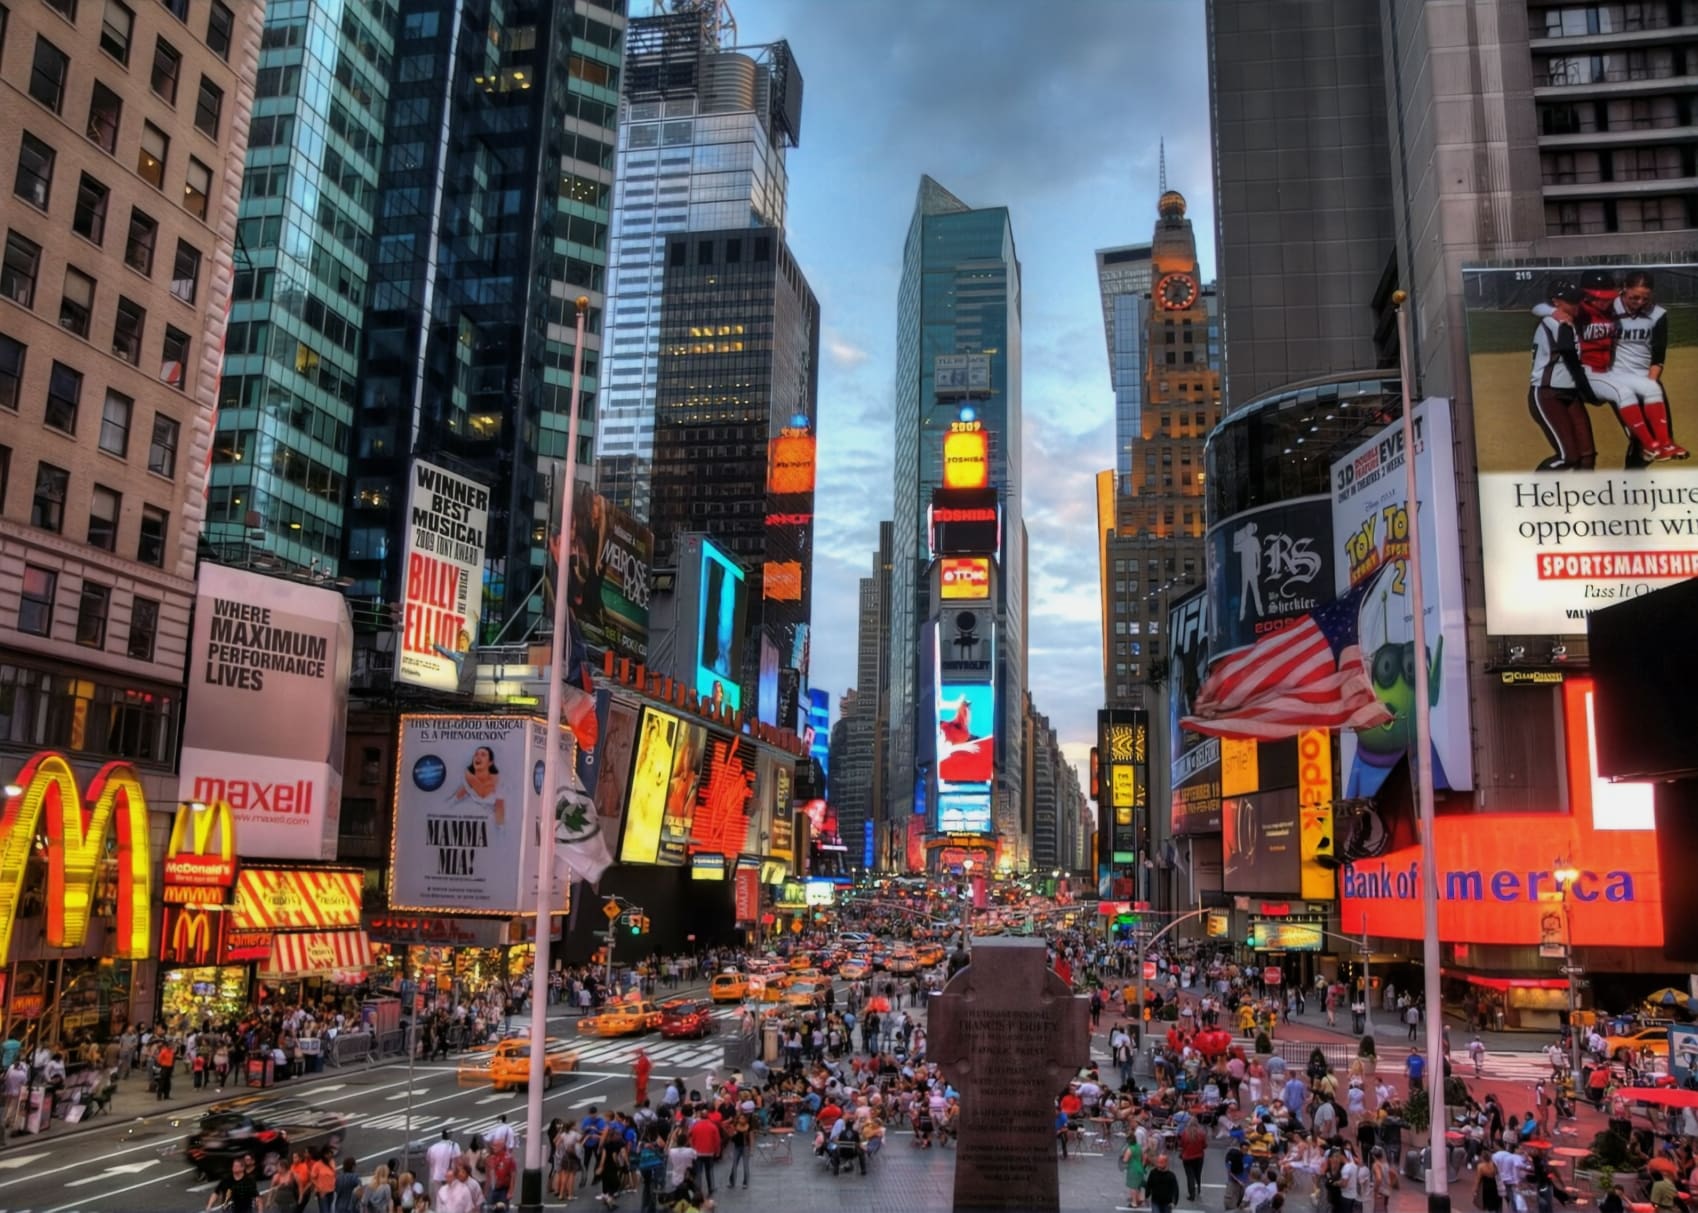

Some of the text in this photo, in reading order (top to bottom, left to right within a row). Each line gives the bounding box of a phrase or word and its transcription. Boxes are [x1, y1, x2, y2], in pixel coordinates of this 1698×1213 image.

[1515, 271, 1532, 281] 215
[1584, 323, 1611, 341] WEST
[951, 421, 982, 433] 2009
[1337, 415, 1423, 491] 3D EVET
[416, 464, 487, 512] WINNER
[1514, 480, 1616, 514] Helped
[431, 493, 471, 524] BEST
[933, 508, 996, 521] TOSHIBA
[411, 506, 484, 549] MUSICAL
[1344, 512, 1377, 567] TOY
[1518, 518, 1653, 546] opponent
[415, 528, 478, 567] 2009 TONY AWARD
[600, 539, 648, 583] MELROSE
[1385, 543, 1409, 557] STOR
[954, 570, 986, 581] TDK
[1263, 531, 1322, 599] RS
[1392, 559, 1407, 596] 2
[1543, 553, 1698, 577] SPORTSMANSHIP
[406, 551, 460, 612] BILLY
[623, 575, 649, 611] PLACE
[1584, 584, 1615, 599] Pass
[1619, 583, 1632, 598] It
[214, 598, 271, 626] WHERE
[210, 616, 328, 662] MAXIMUM
[403, 602, 466, 660] ELLIOT
[208, 643, 326, 678] PERFORMANCE
[205, 662, 264, 691] LIVES
[420, 730, 430, 740] IS
[432, 730, 438, 740] A
[485, 719, 524, 730] MUSICAL
[193, 776, 313, 815] maxell
[425, 819, 489, 848] MAMMA
[165, 862, 231, 875] McDonald's
[437, 848, 476, 876] MIA!
[1344, 862, 1634, 902] Bank of merca
